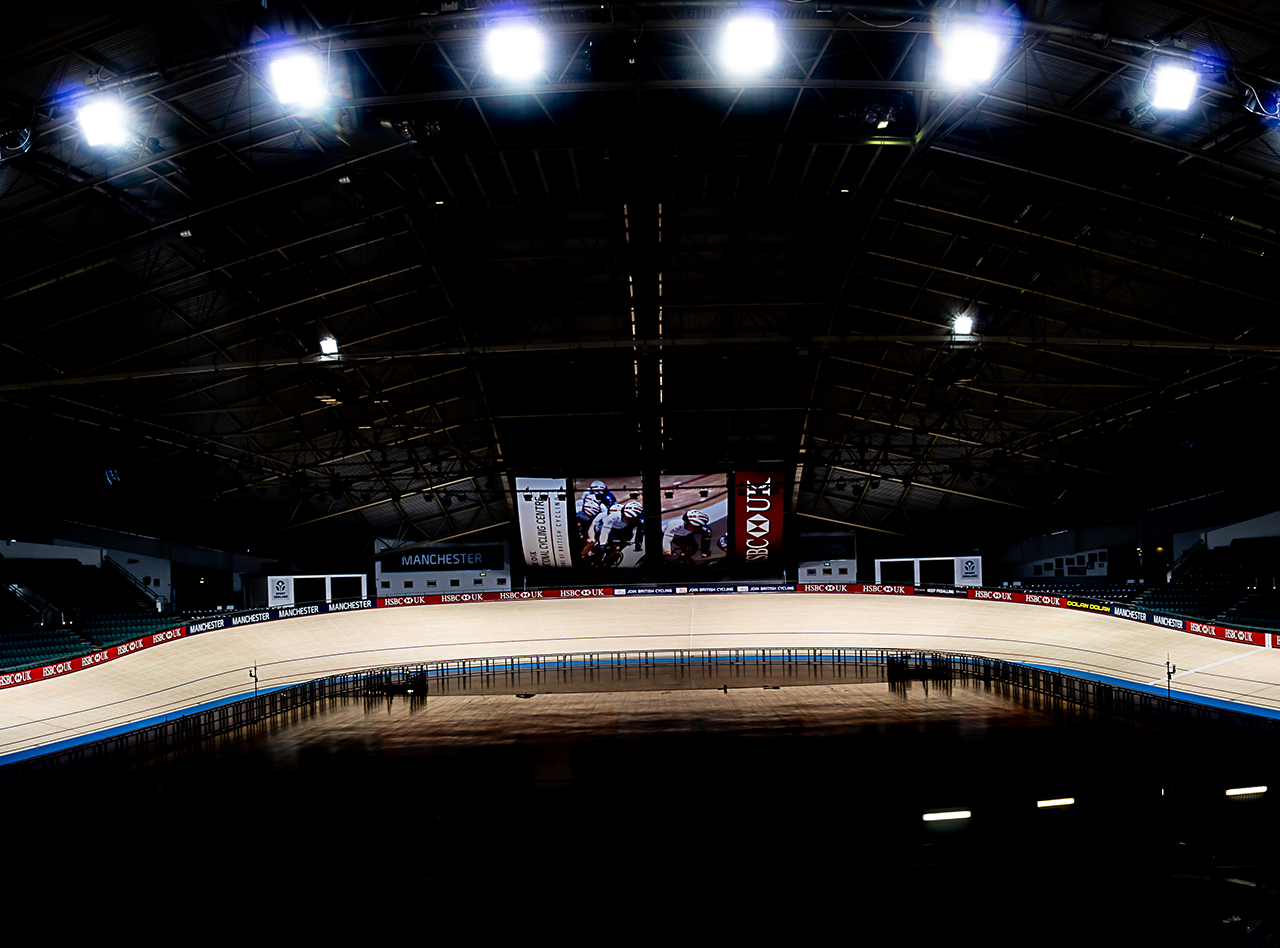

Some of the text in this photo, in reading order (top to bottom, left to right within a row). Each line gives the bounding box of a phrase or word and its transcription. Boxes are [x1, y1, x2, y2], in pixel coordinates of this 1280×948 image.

[746, 477, 772, 513] UK
[537, 526, 548, 550] CYCLING
[402, 552, 482, 565] MANCHESTER
[863, 585, 882, 593] HSBC
[975, 590, 992, 599] HSBC
[1001, 592, 1012, 600] UK
[384, 598, 403, 606] HSBC
[471, 593, 483, 601] UK
[1026, 595, 1060, 605] HSBC UK
[329, 600, 371, 611] MANCHESTER
[1068, 600, 1088, 608] DOLAN
[232, 612, 270, 625] MANCHESTER
[278, 606, 319, 618] MANCHESTER
[1114, 606, 1146, 621] MANCHESTER
[190, 620, 224, 632] MANCHESTER
[1154, 615, 1182, 629] MANCHESTER
[1190, 622, 1216, 636] HSBC UK
[1225, 628, 1252, 642] HSBC UK
[153, 628, 181, 644] HSBC UK
[117, 640, 143, 655] HSBC UK
[82, 651, 108, 667] HSBC UK
[42, 661, 72, 677] HSBC UK
[22, 670, 32, 682] UK
